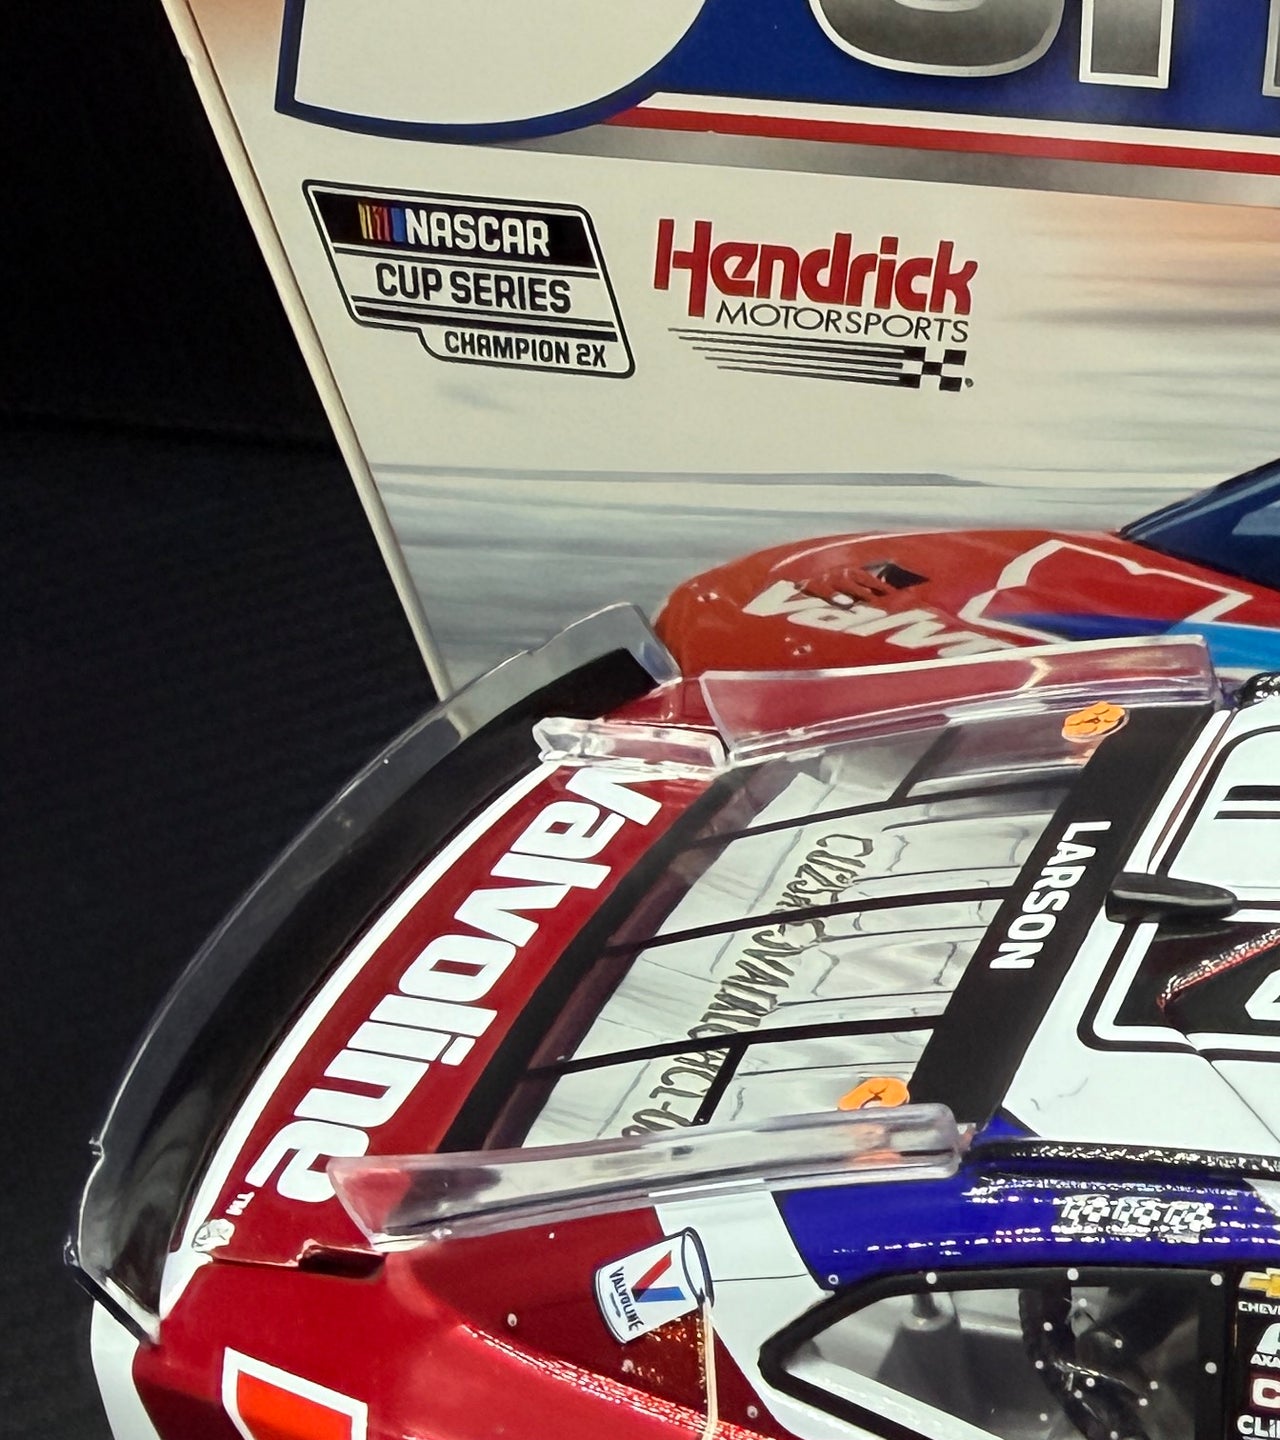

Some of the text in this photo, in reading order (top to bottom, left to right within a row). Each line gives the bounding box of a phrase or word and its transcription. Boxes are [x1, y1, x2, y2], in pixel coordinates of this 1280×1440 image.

[404, 207, 550, 257] NASCAR
[375, 262, 571, 314] CUP SERIES
[654, 218, 978, 318] Hendrick
[444, 330, 607, 368] CHAMPION 2X
[715, 300, 969, 342] MOTORSPORTS
[988, 819, 1112, 970] LARSON
[244, 765, 663, 1204] Valvoline
[609, 1266, 645, 1332] VALVOLINE
